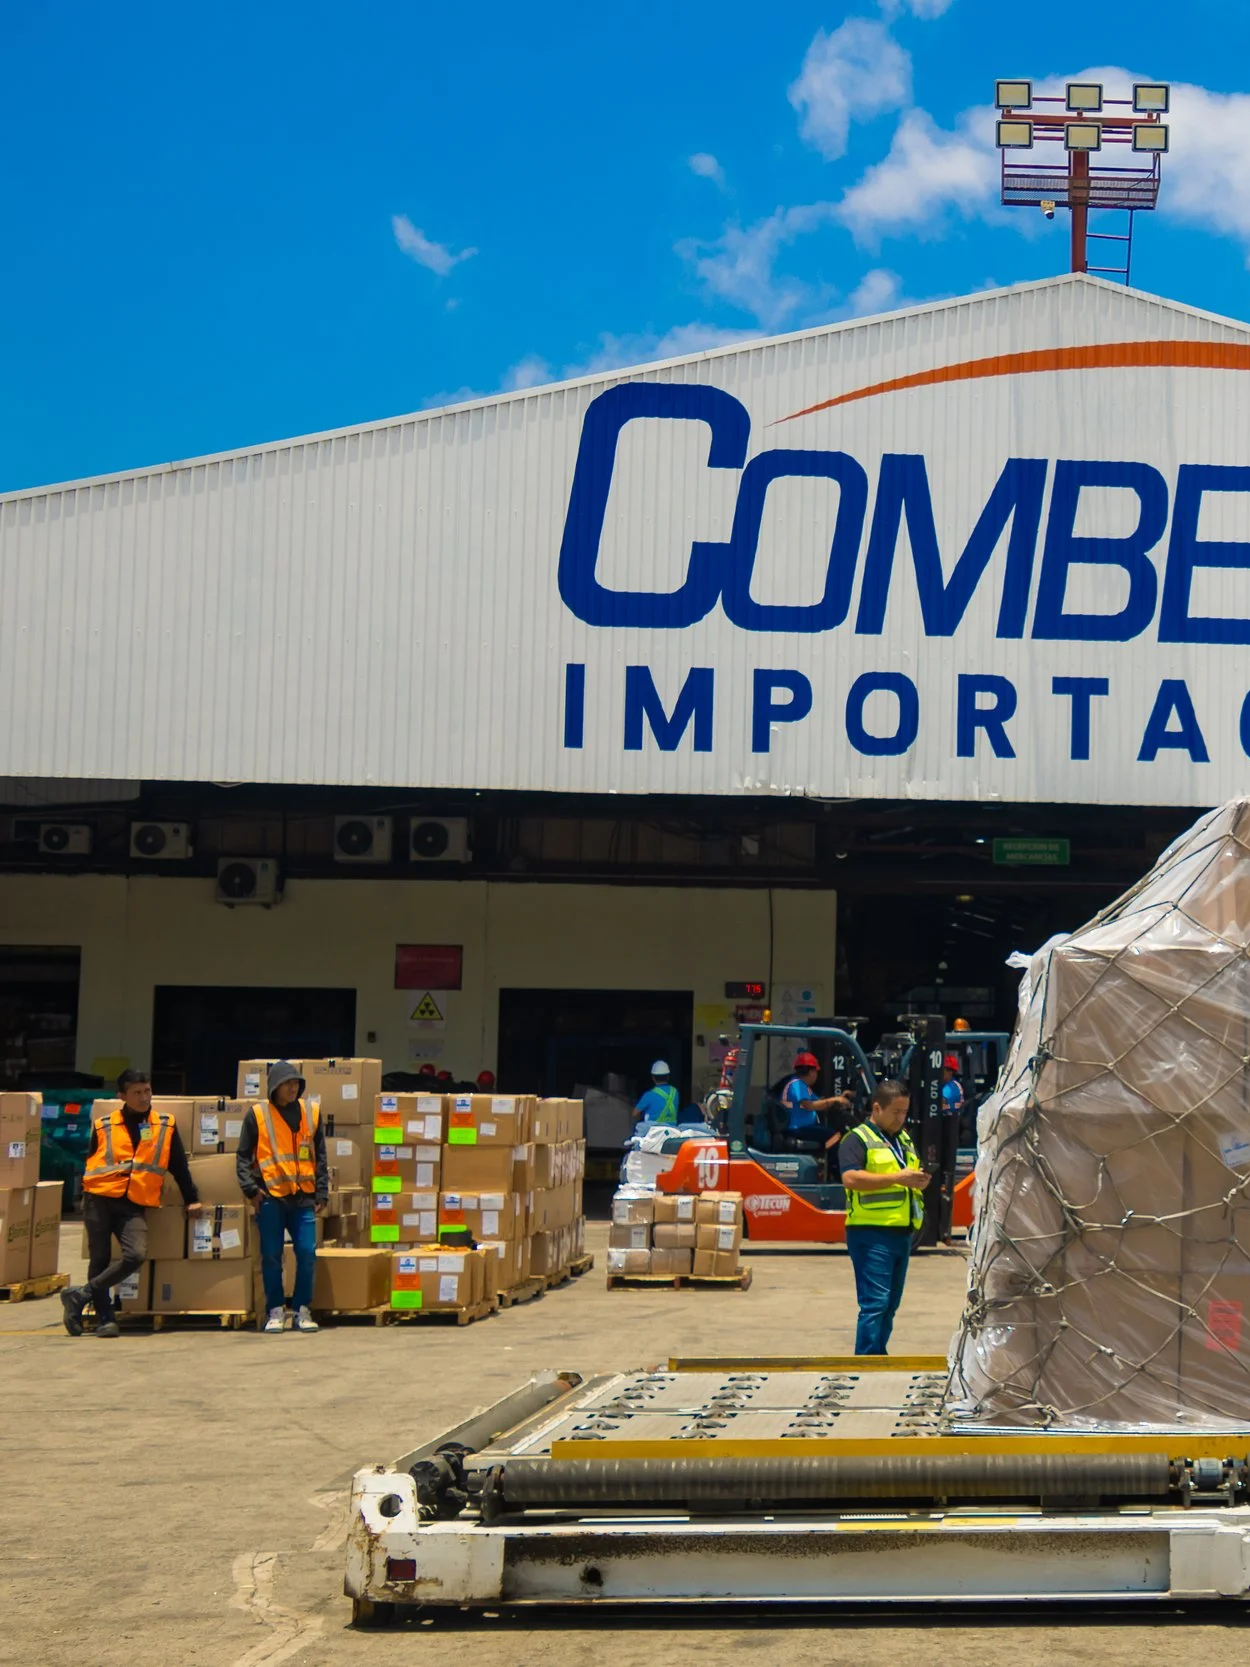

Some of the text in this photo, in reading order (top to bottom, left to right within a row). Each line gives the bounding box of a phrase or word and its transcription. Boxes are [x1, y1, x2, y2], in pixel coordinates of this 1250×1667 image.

[833, 1056, 844, 1070] 12
[930, 1051, 942, 1068] 10
[930, 1080, 938, 1118] TOOTA
[694, 1147, 719, 1189] 10
